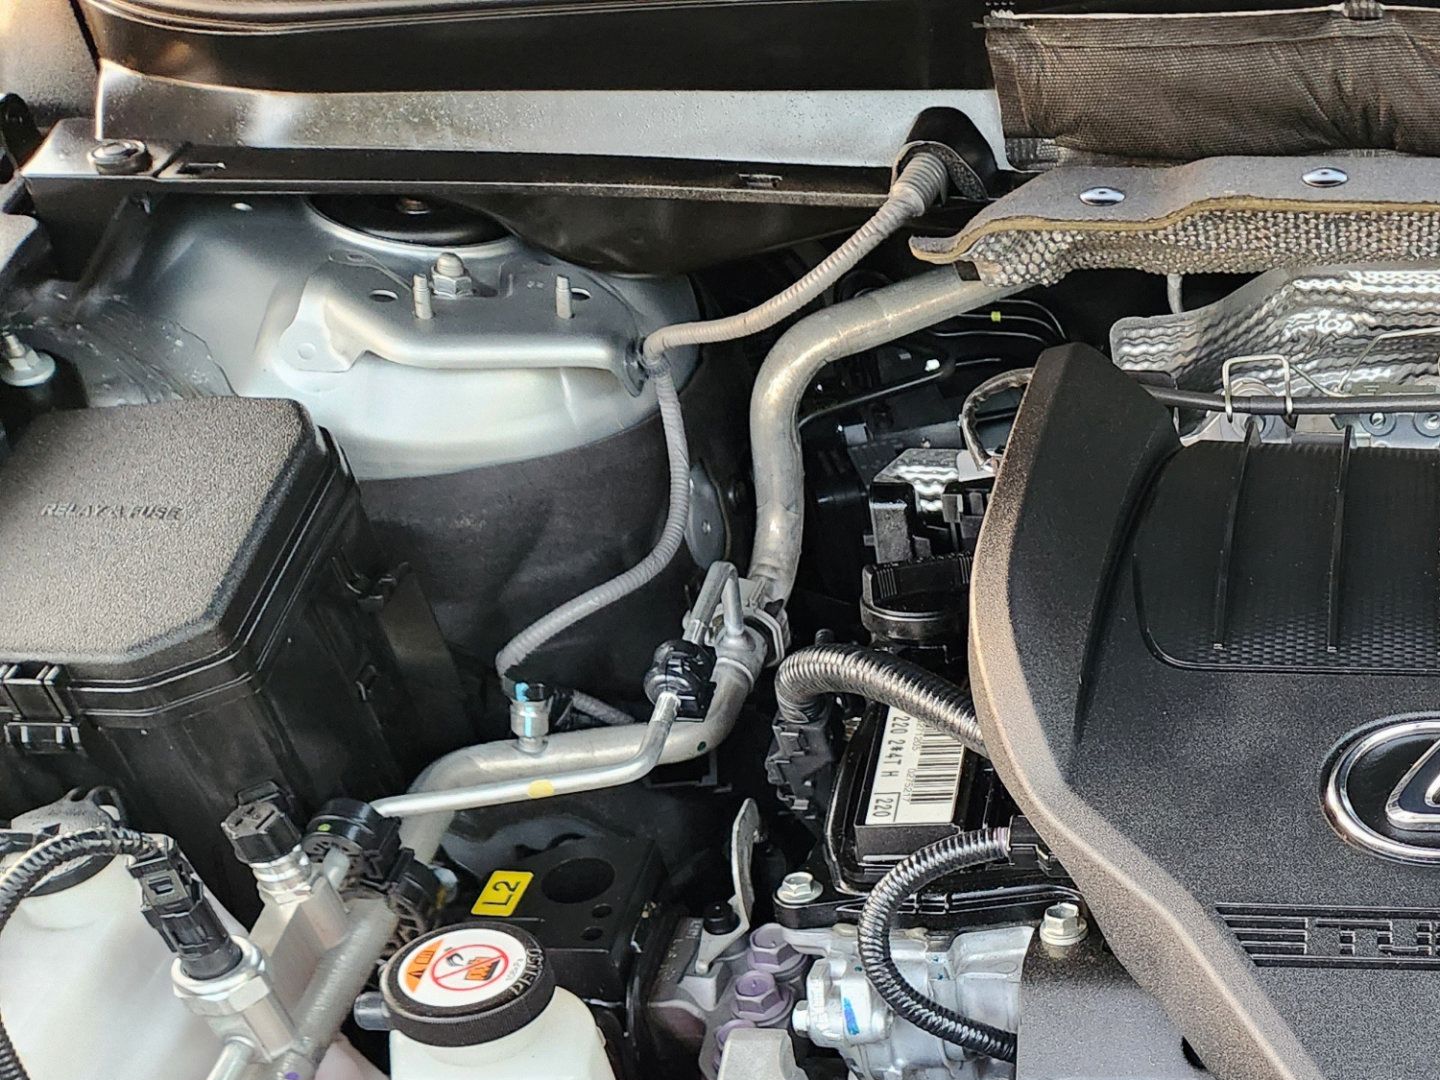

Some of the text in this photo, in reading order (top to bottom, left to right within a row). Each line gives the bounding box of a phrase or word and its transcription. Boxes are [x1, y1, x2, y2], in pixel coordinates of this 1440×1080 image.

[41, 502, 108, 517] RELAY
[128, 504, 184, 520] FUSE
[890, 716, 911, 735] 220
[880, 770, 900, 778] H
[872, 797, 894, 818] 220
[482, 880, 522, 906] L2
